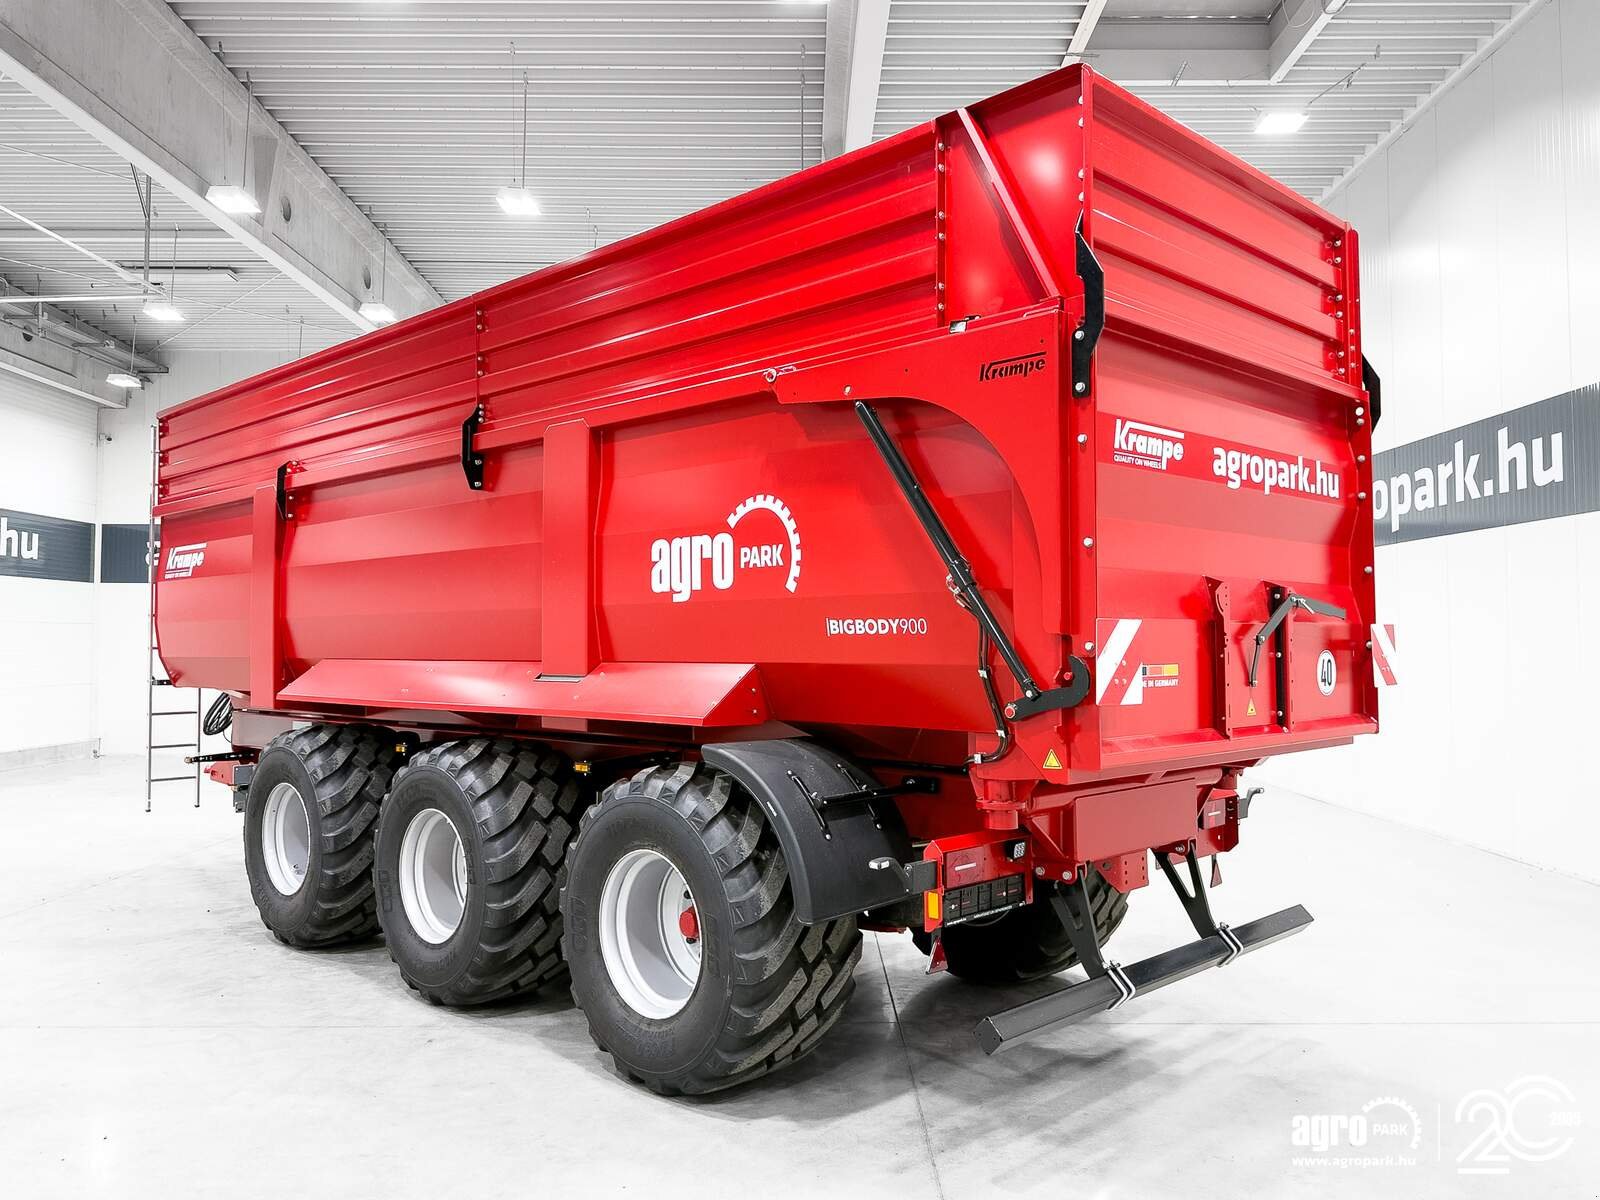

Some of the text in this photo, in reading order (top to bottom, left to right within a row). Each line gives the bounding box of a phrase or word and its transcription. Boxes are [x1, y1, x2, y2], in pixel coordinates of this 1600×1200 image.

[979, 351, 1047, 382] Krampe
[1113, 418, 1185, 470] Krampe
[1113, 454, 1162, 469] QUALITY ON WHEELS
[1212, 445, 1341, 499] agropark.hu
[165, 542, 208, 576] Krampe
[650, 532, 784, 603] agro PARK
[1154, 678, 1179, 687] GERMANY
[1319, 657, 1333, 687] 40
